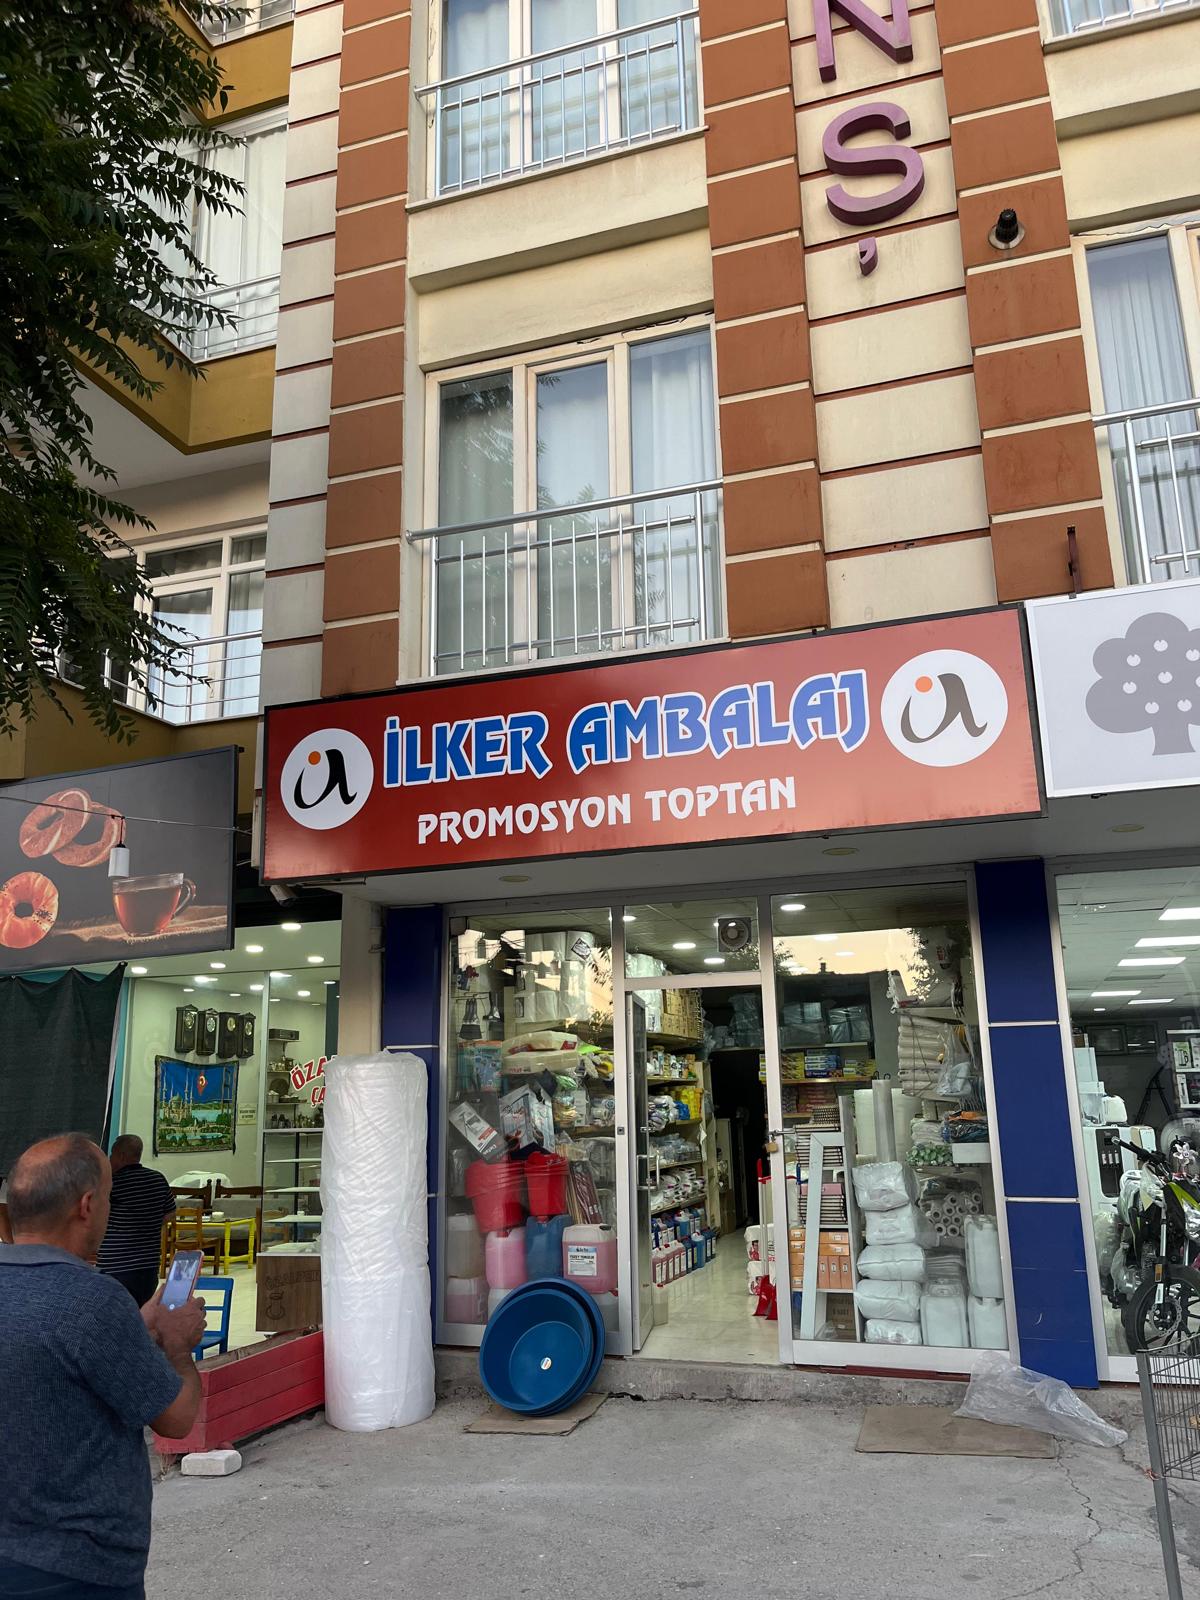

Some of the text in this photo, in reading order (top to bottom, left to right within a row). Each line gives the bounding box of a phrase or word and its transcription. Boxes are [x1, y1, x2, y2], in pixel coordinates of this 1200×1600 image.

[383, 669, 870, 789] İLKER AMBALAJ
[417, 776, 797, 844] PROMOSYON TOPTAN
